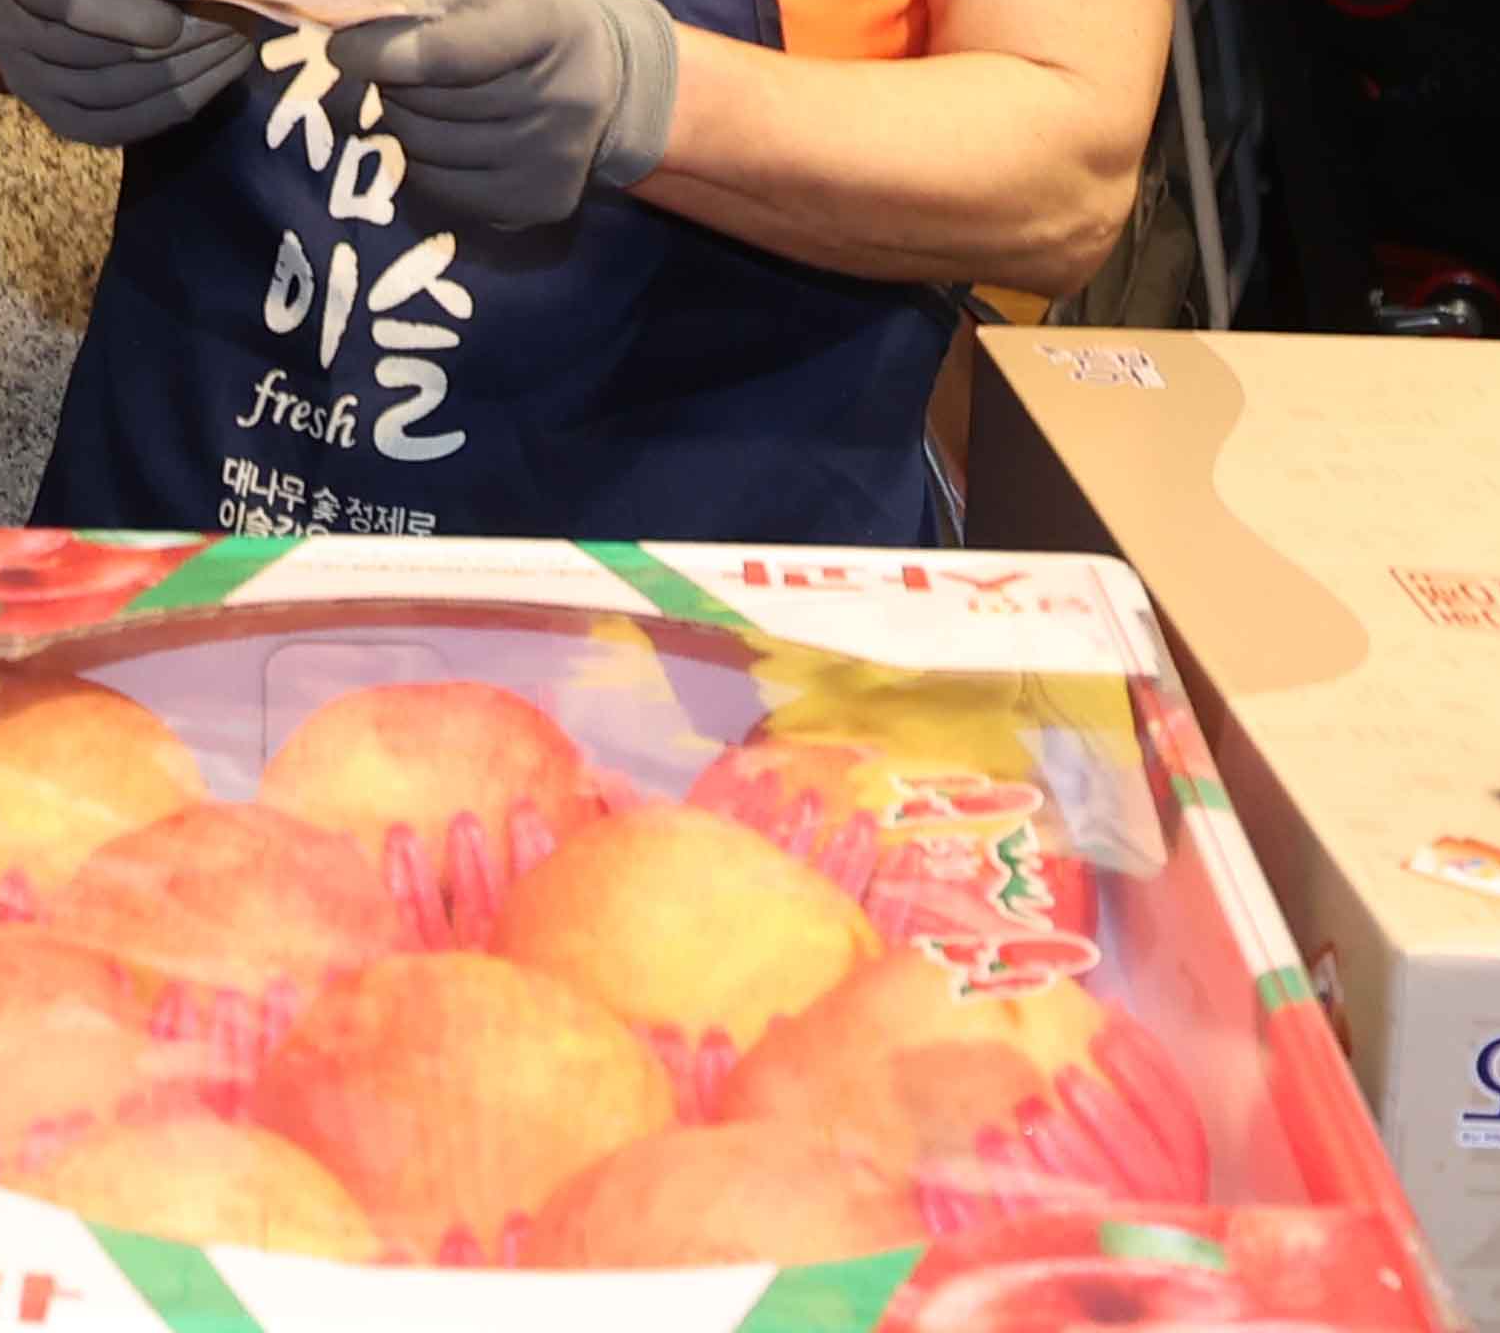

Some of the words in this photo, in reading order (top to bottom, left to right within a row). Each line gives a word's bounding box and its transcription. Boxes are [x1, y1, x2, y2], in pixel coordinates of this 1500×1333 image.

[236, 368, 359, 450] fresh
[221, 456, 307, 514] 대나무
[345, 495, 437, 536] 정제로
